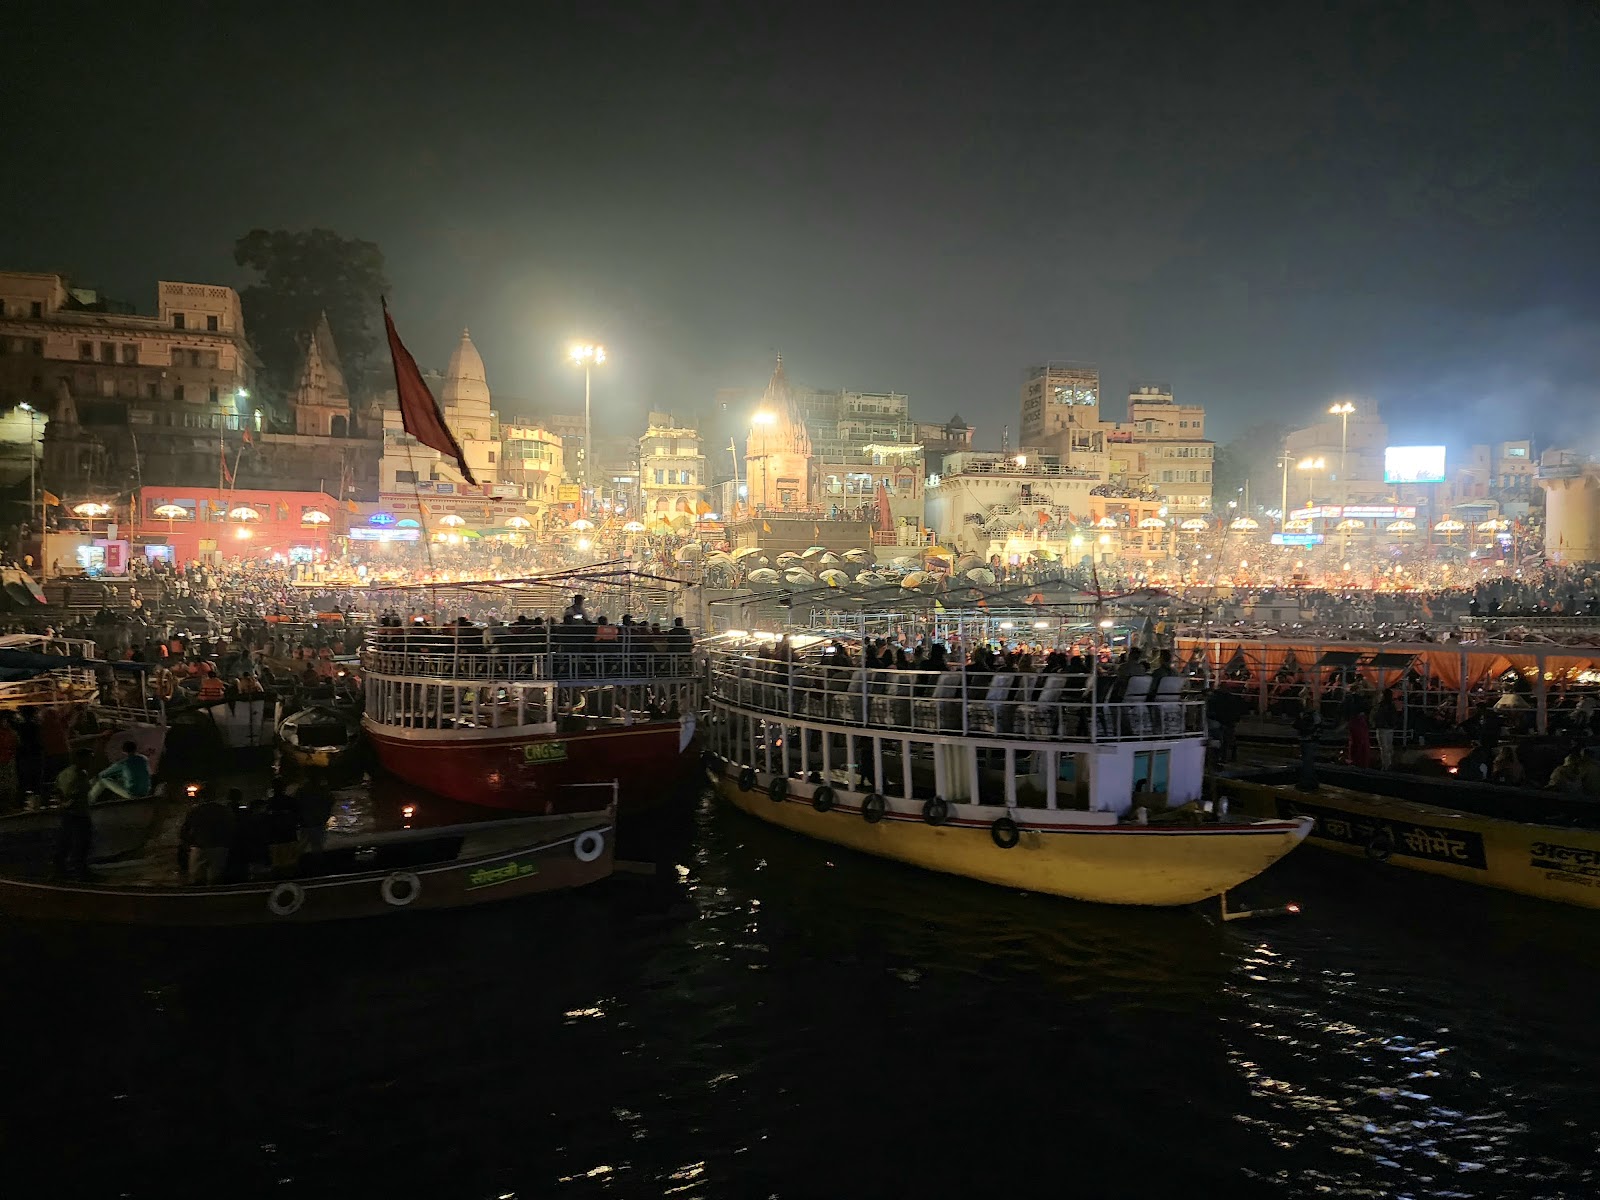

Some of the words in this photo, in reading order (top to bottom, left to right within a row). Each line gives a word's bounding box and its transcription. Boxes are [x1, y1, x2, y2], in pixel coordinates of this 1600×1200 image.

[1024, 396, 1042, 411] GUEST
[1024, 409, 1041, 424] HOUSE
[524, 743, 550, 760] CNG
[1402, 827, 1469, 860] सीमेंट
